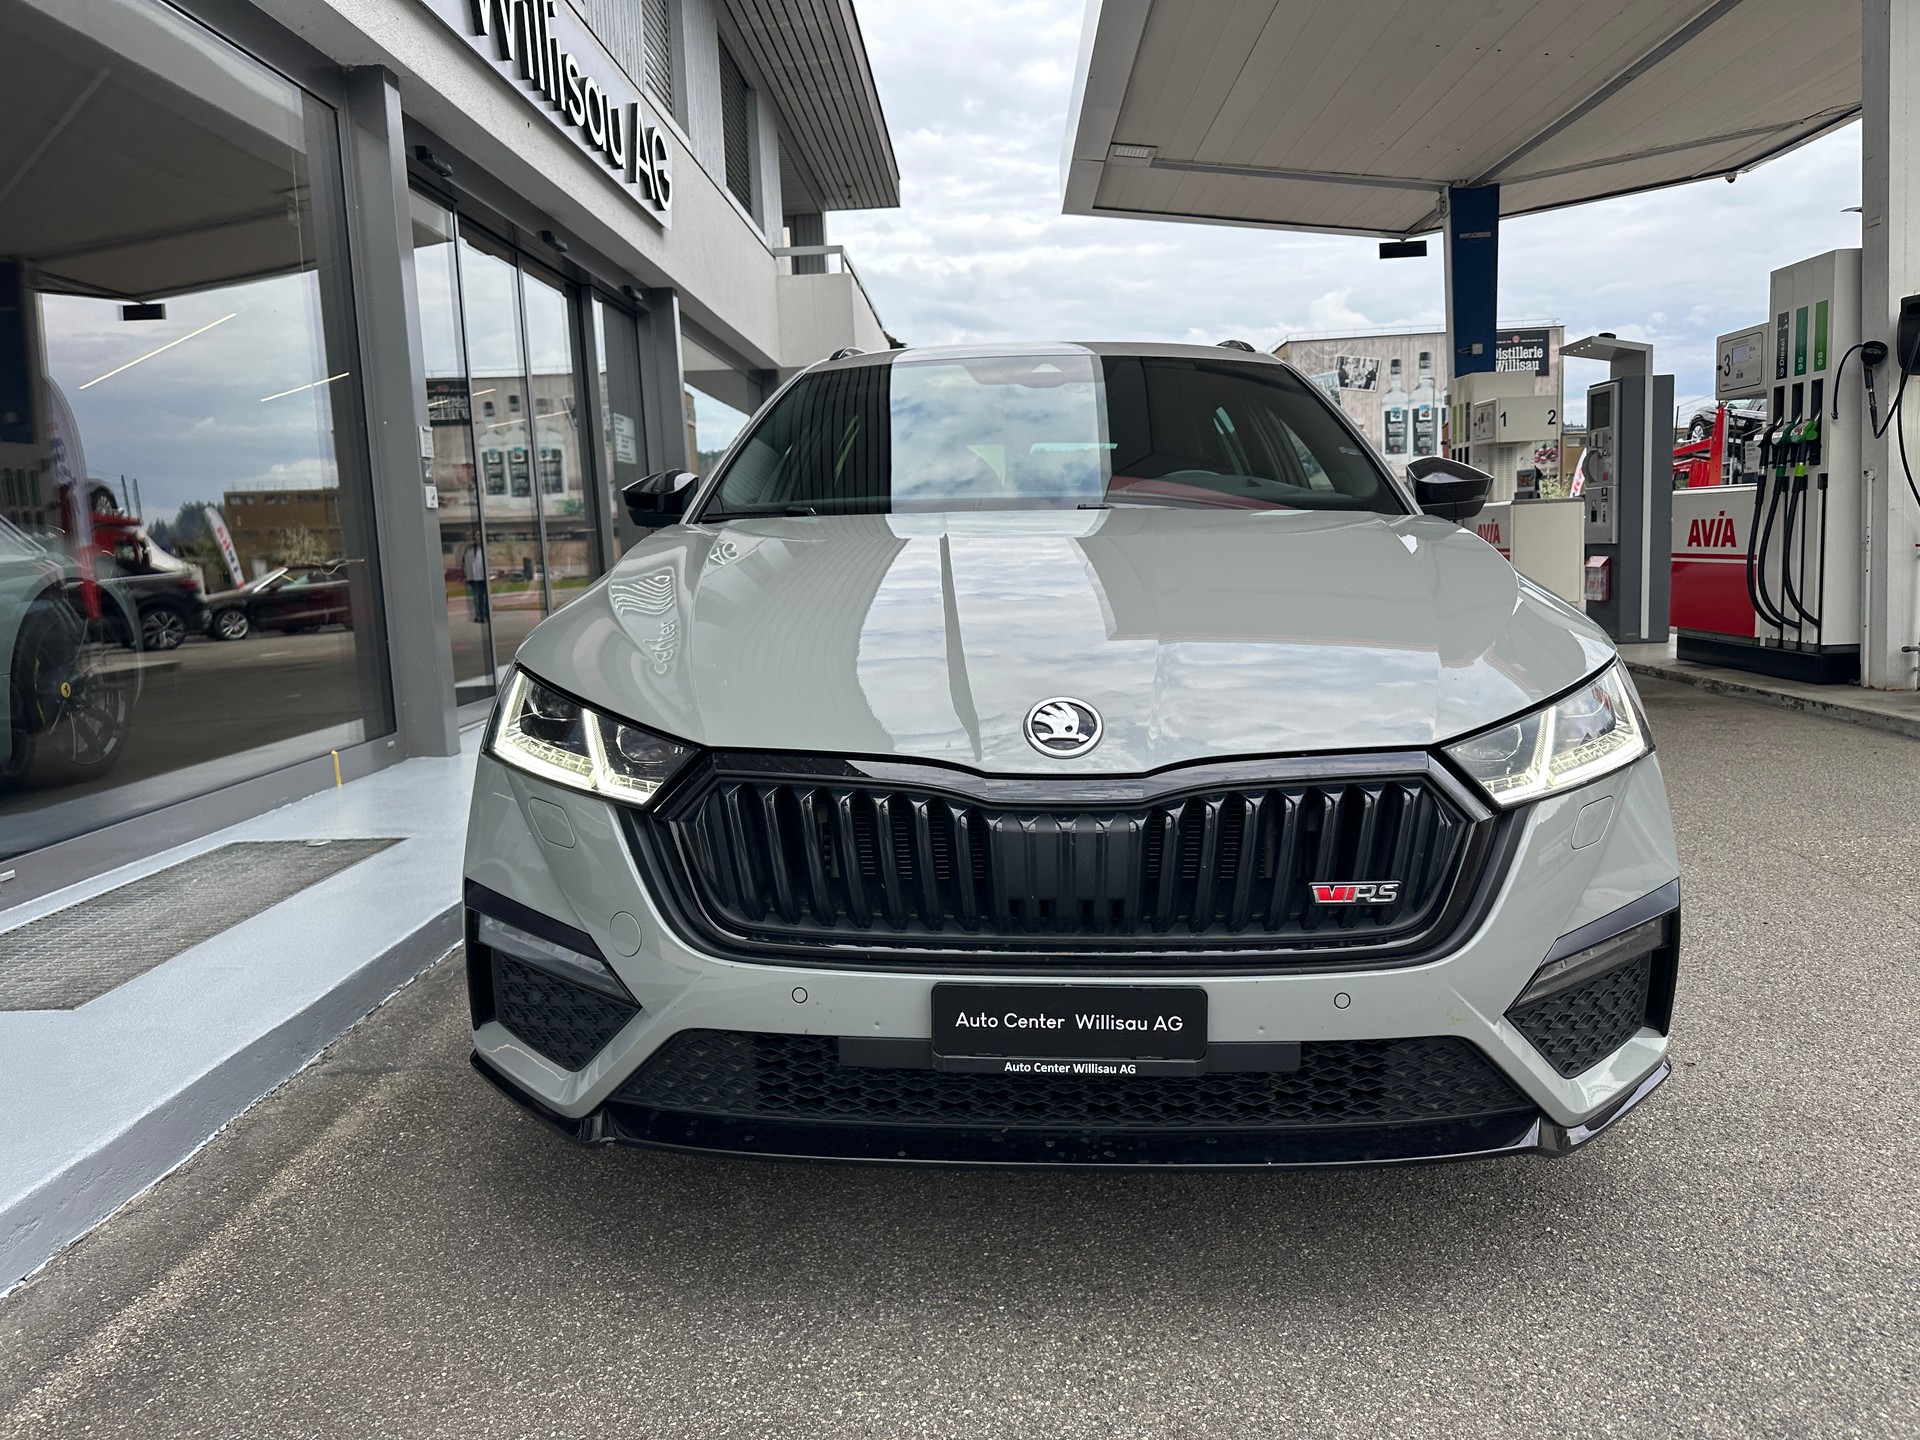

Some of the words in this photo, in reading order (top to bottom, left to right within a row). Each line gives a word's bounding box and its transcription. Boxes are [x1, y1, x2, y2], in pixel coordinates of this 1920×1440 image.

[629, 102, 673, 211] AG
[1723, 353, 1731, 377] 3
[1500, 411, 1507, 427] 1
[1547, 409, 1556, 425] 2
[955, 1011, 999, 1029] Auto
[1003, 1012, 1066, 1030] Center
[1075, 1013, 1148, 1031] Willisau
[1153, 1015, 1184, 1032] AG
[1004, 1061, 1031, 1073] Auto
[1033, 1062, 1071, 1074] Center
[1072, 1063, 1117, 1075] Willisau
[1119, 1064, 1136, 1075] AG
